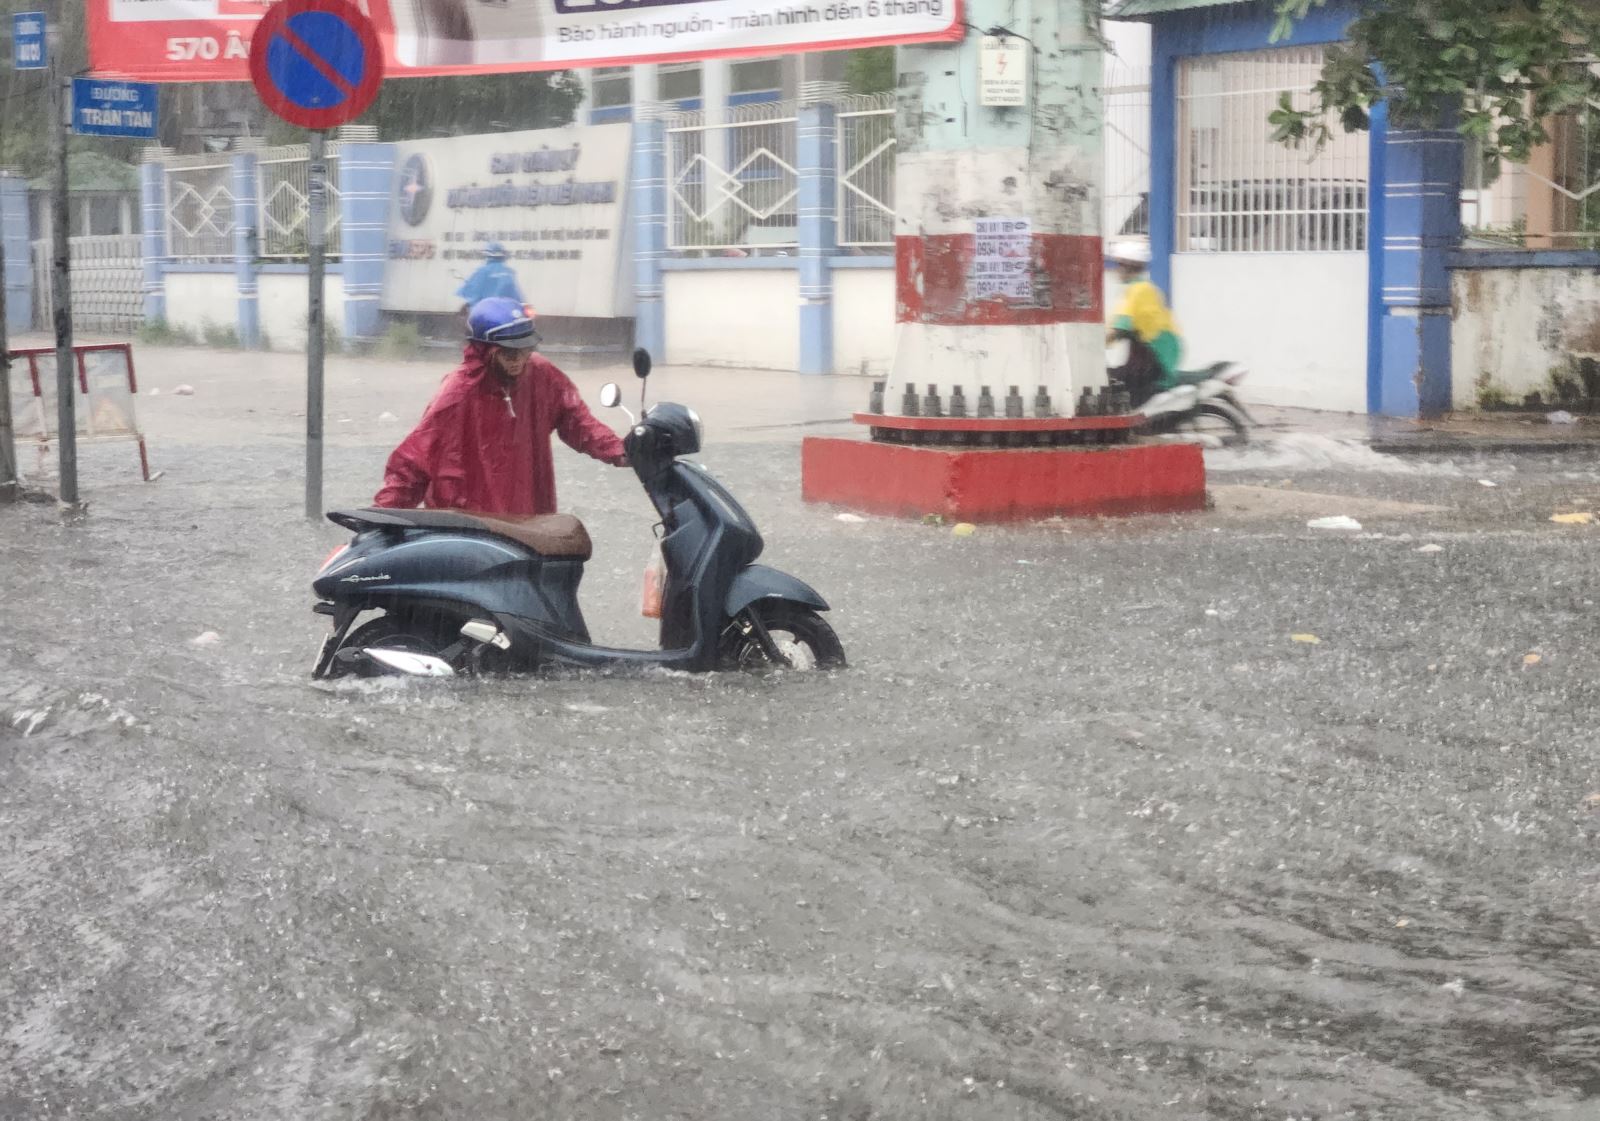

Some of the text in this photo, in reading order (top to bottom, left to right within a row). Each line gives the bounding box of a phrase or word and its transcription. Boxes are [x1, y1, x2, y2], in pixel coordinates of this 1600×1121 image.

[557, 24, 596, 43] Bảo
[598, 21, 649, 40] hành
[651, 11, 713, 38] nguồn
[730, 9, 773, 29] màn
[866, 0, 881, 17] 6
[165, 36, 220, 60] 570
